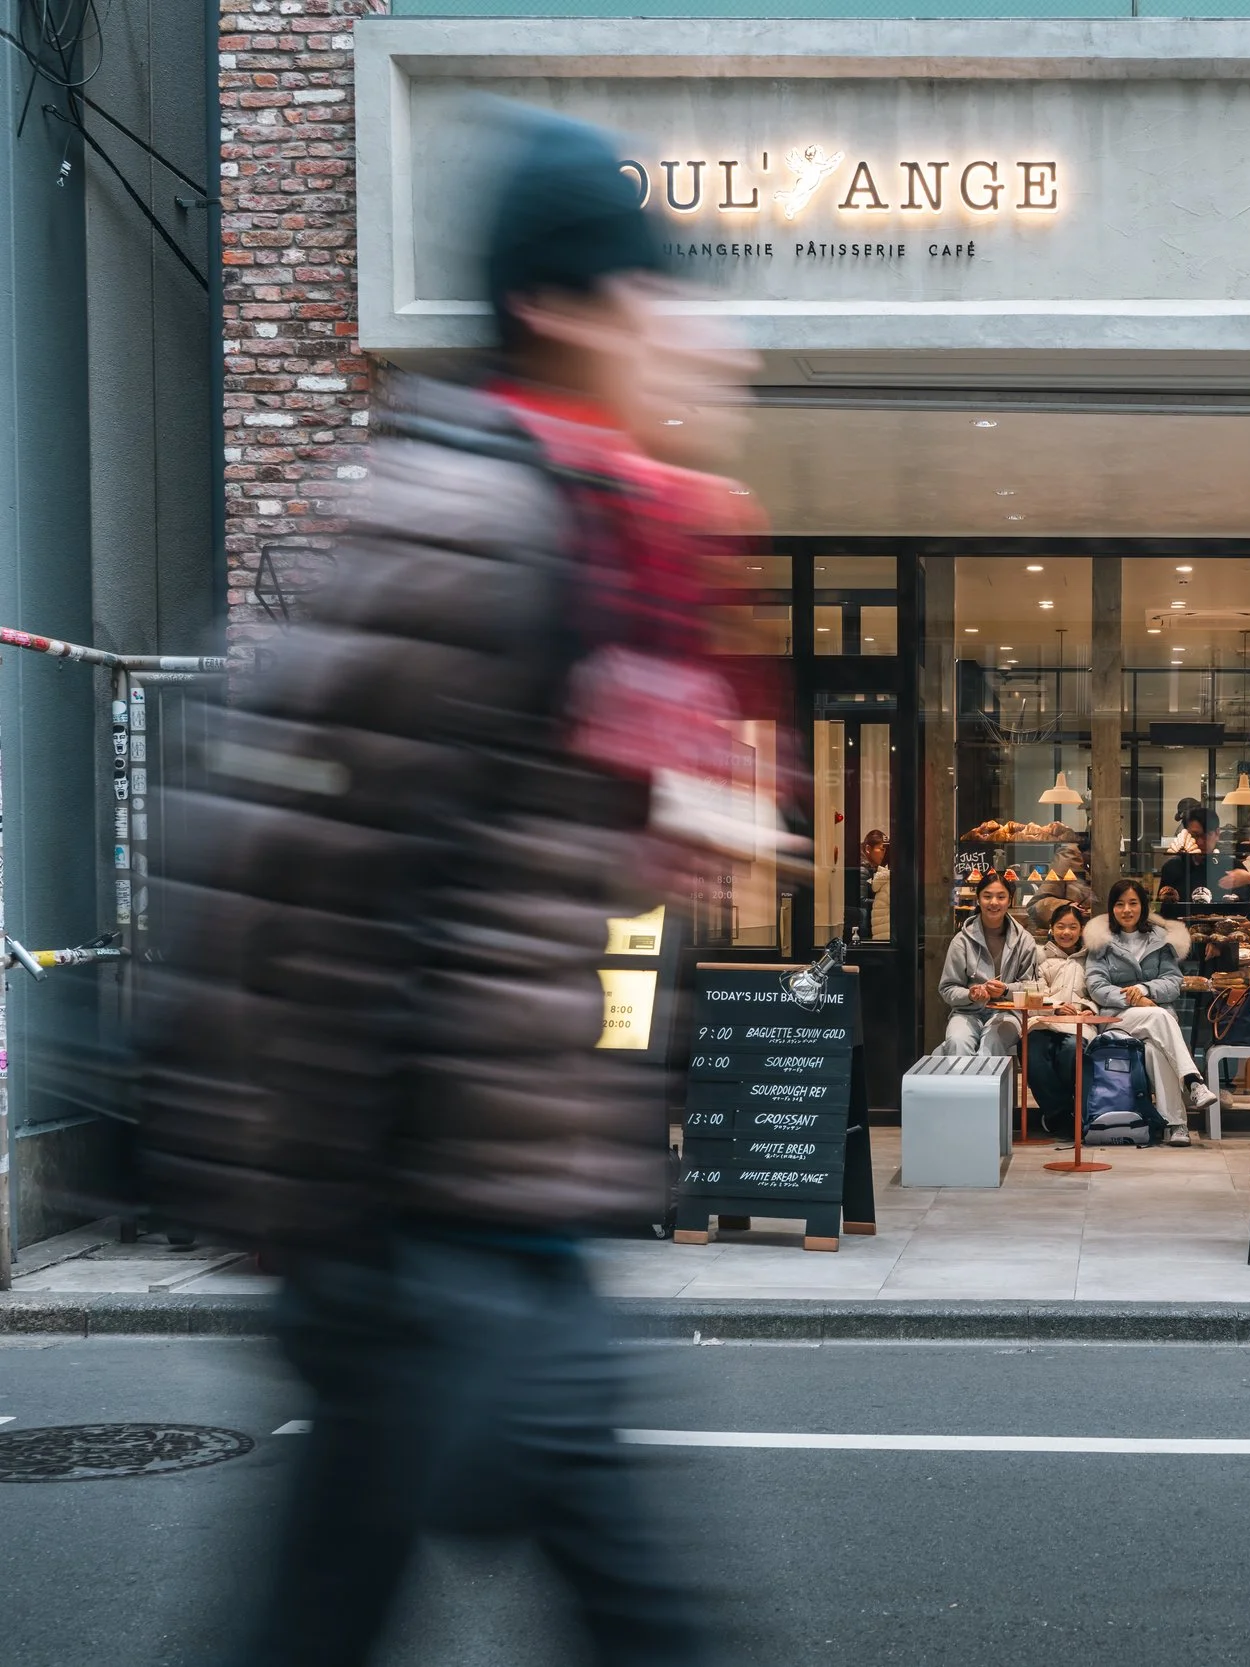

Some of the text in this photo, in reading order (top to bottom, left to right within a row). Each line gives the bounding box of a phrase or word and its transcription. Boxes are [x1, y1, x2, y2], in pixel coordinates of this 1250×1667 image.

[662, 240, 976, 257] ULANGERIE PÂTISSERIE CAFÉ
[959, 852, 986, 863] JUST
[957, 862, 990, 874] BAKED
[706, 990, 751, 1002] TODAY'S
[753, 992, 778, 1002] JUST
[819, 993, 844, 1004] TIME
[610, 1005, 633, 1014] 8:00
[602, 1019, 631, 1028] 20:00
[745, 1027, 792, 1038] BAGUETTE
[822, 1028, 846, 1039] GOLD
[764, 1056, 824, 1069] SOURDOUGH
[750, 1084, 828, 1098] SOURDOUGH REY
[754, 1113, 819, 1127] CROISSANT
[750, 1142, 816, 1155] WHITE BREAD
[739, 1171, 770, 1182] WHITE
[770, 1171, 799, 1182] BREAD
